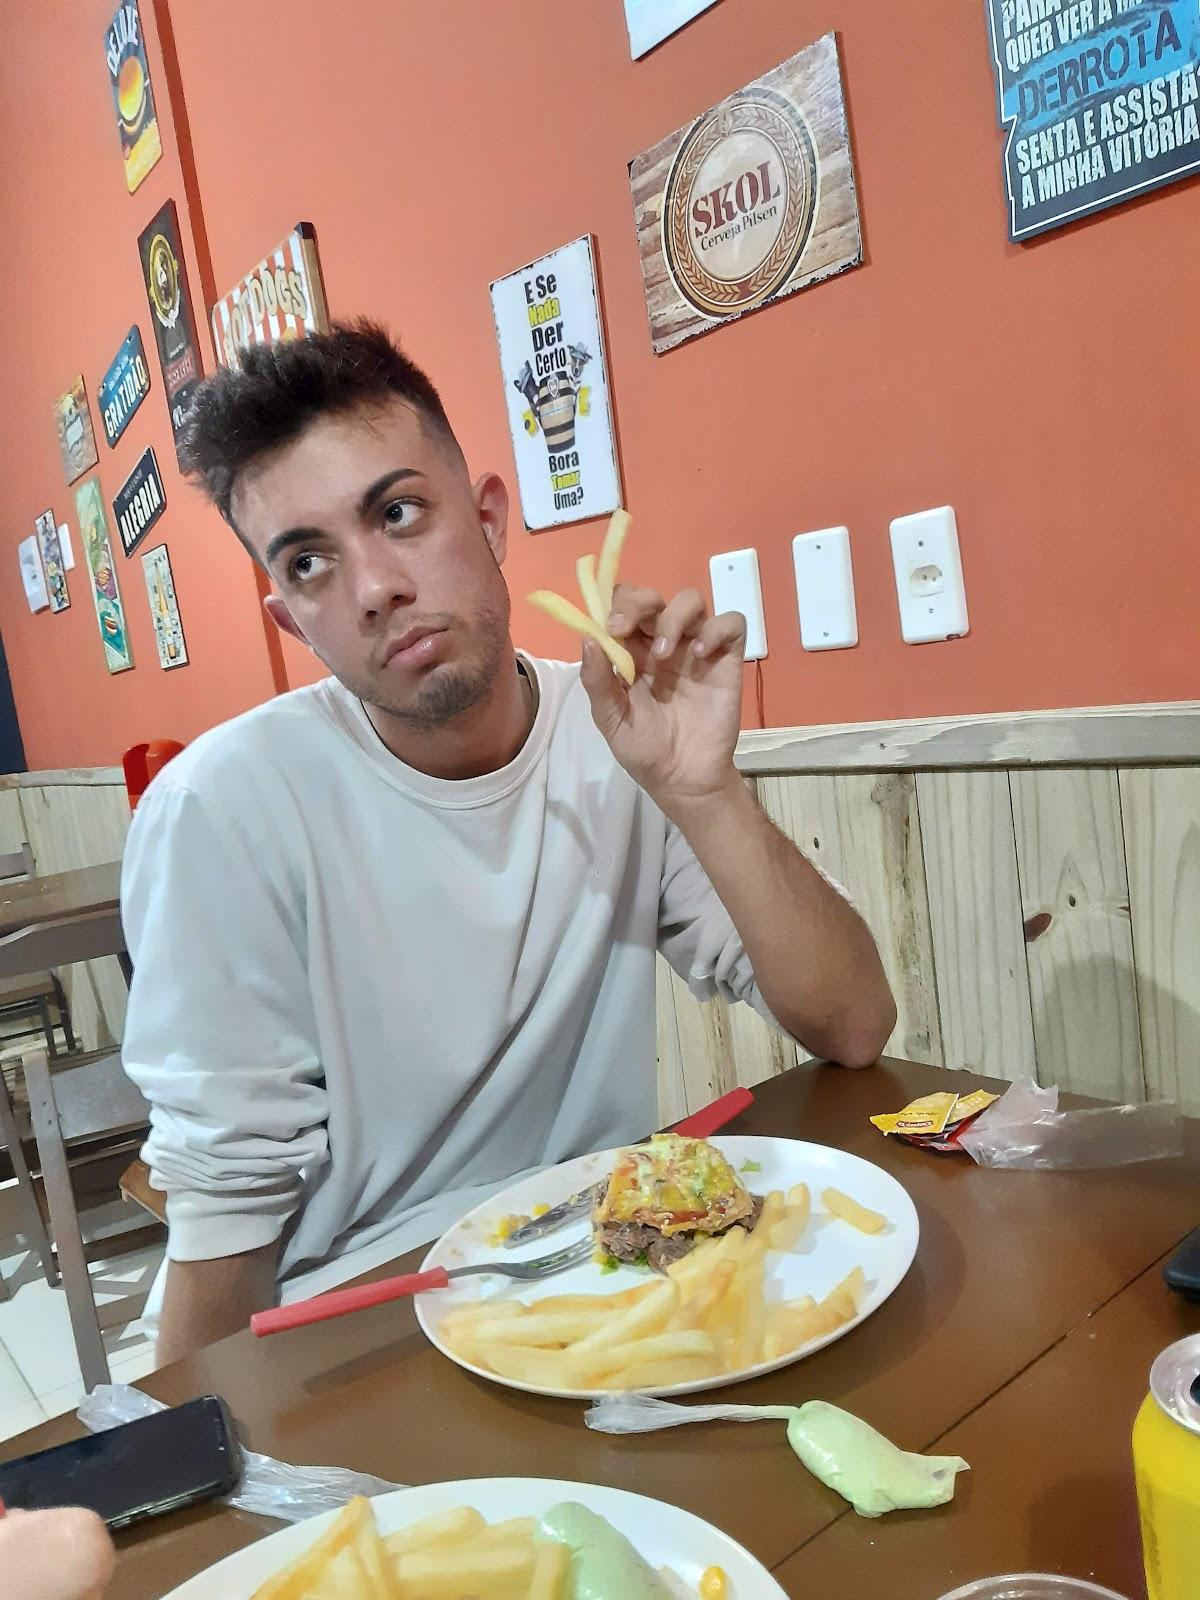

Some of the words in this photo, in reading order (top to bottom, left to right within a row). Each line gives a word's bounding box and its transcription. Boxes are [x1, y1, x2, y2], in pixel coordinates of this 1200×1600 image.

[1005, 19, 1054, 73] QUER
[1055, 7, 1094, 45] VER
[1017, 9, 1182, 121] DERROTA
[1016, 117, 1081, 174] SENTA
[1083, 109, 1097, 146] E
[1100, 62, 1199, 140] ASSISTA
[692, 161, 781, 239] SKOL
[1022, 175, 1036, 210] A
[1037, 144, 1106, 203] MINHA
[701, 224, 741, 251] Cerveja
[742, 205, 777, 230] Pilsen
[250, 267, 308, 325] DOGS
[524, 281, 535, 304] E
[535, 273, 558, 298] Se
[528, 296, 561, 327] Nada
[531, 320, 565, 352] Der
[535, 347, 567, 377] Certo
[104, 354, 149, 439] GRATIDÃO
[548, 450, 580, 474] Bora
[551, 469, 581, 493] Tomar
[120, 473, 161, 548] ALEGRIA
[554, 487, 585, 511] Uma?
